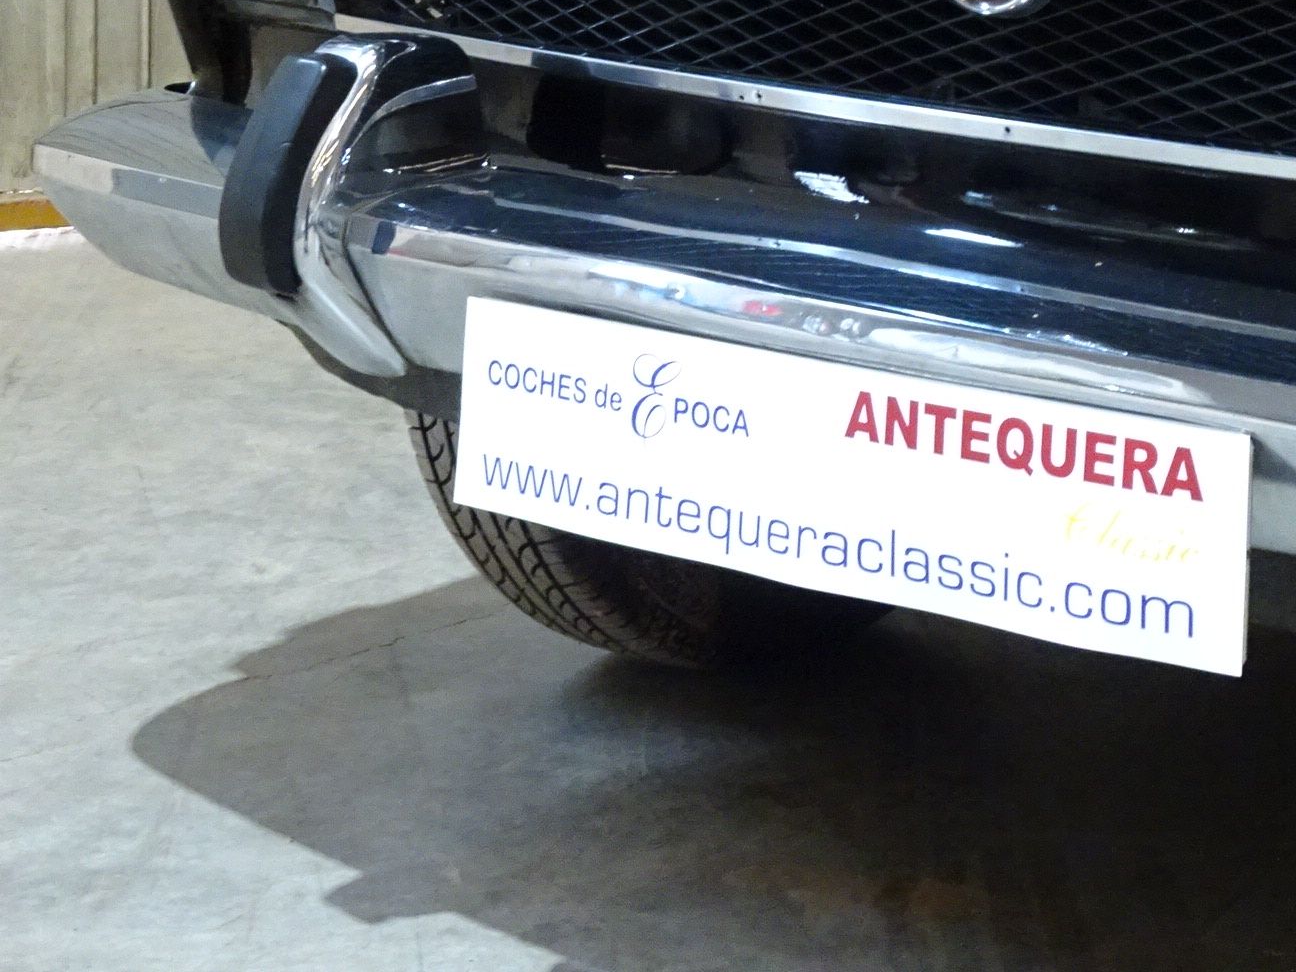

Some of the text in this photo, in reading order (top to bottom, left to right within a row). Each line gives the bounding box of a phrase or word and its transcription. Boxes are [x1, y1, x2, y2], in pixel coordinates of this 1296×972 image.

[488, 360, 586, 404] COCHES
[594, 383, 622, 412] de
[845, 391, 1204, 502] ANTEQUERA
[483, 454, 1194, 637] www.antequeraclassic.com
